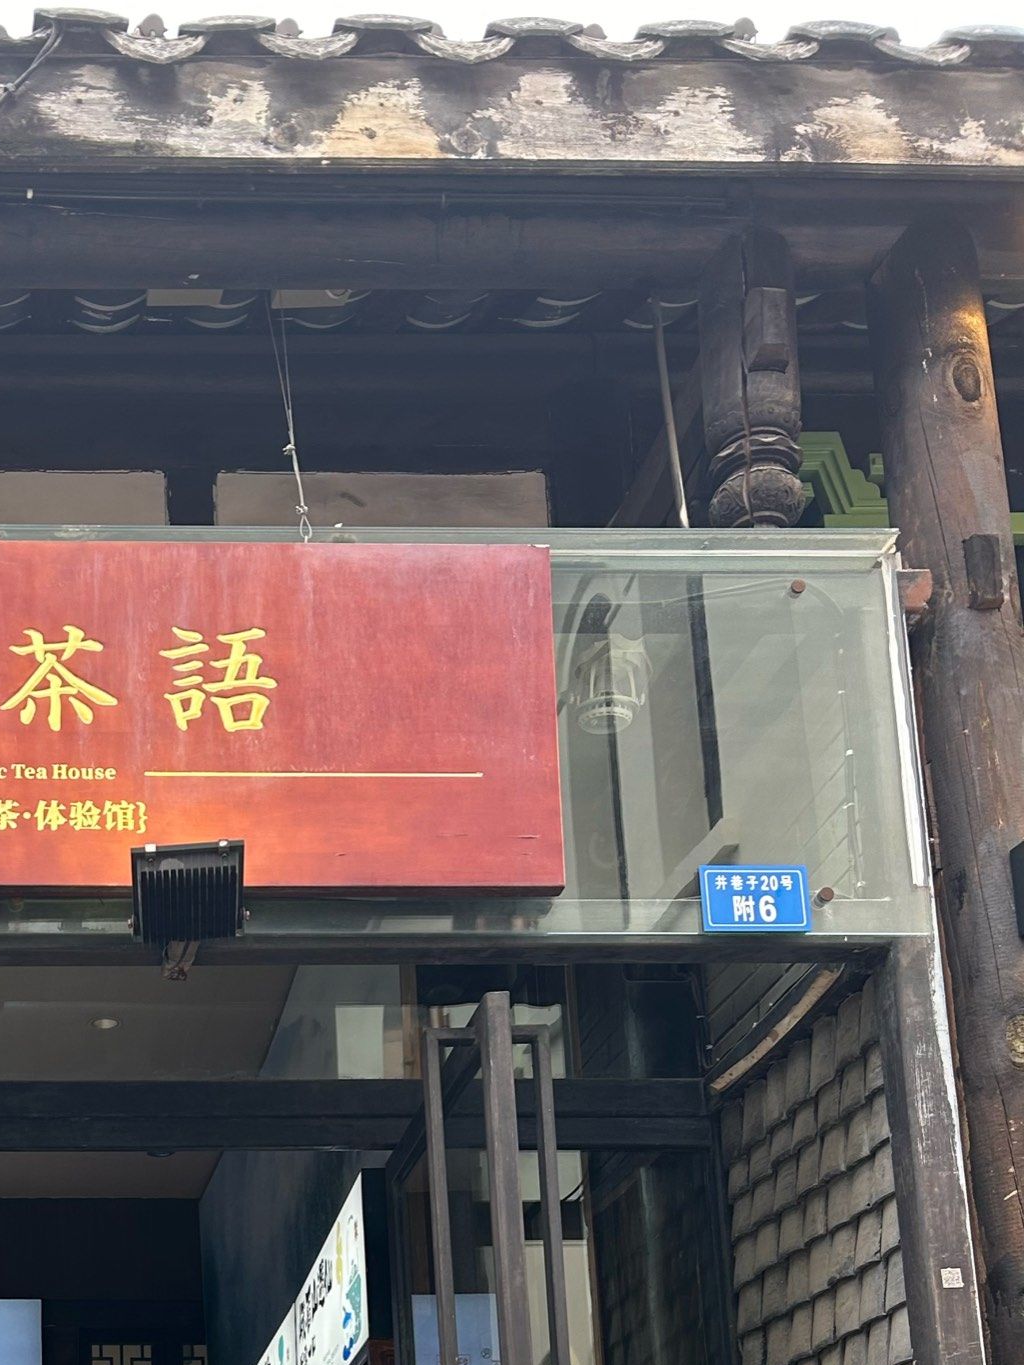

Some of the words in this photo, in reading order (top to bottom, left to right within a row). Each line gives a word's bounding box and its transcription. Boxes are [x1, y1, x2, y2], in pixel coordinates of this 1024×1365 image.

[11, 764, 48, 780] Tea
[52, 764, 116, 780] House
[715, 875, 793, 891] 井巷子20号
[732, 895, 777, 922] 附6
